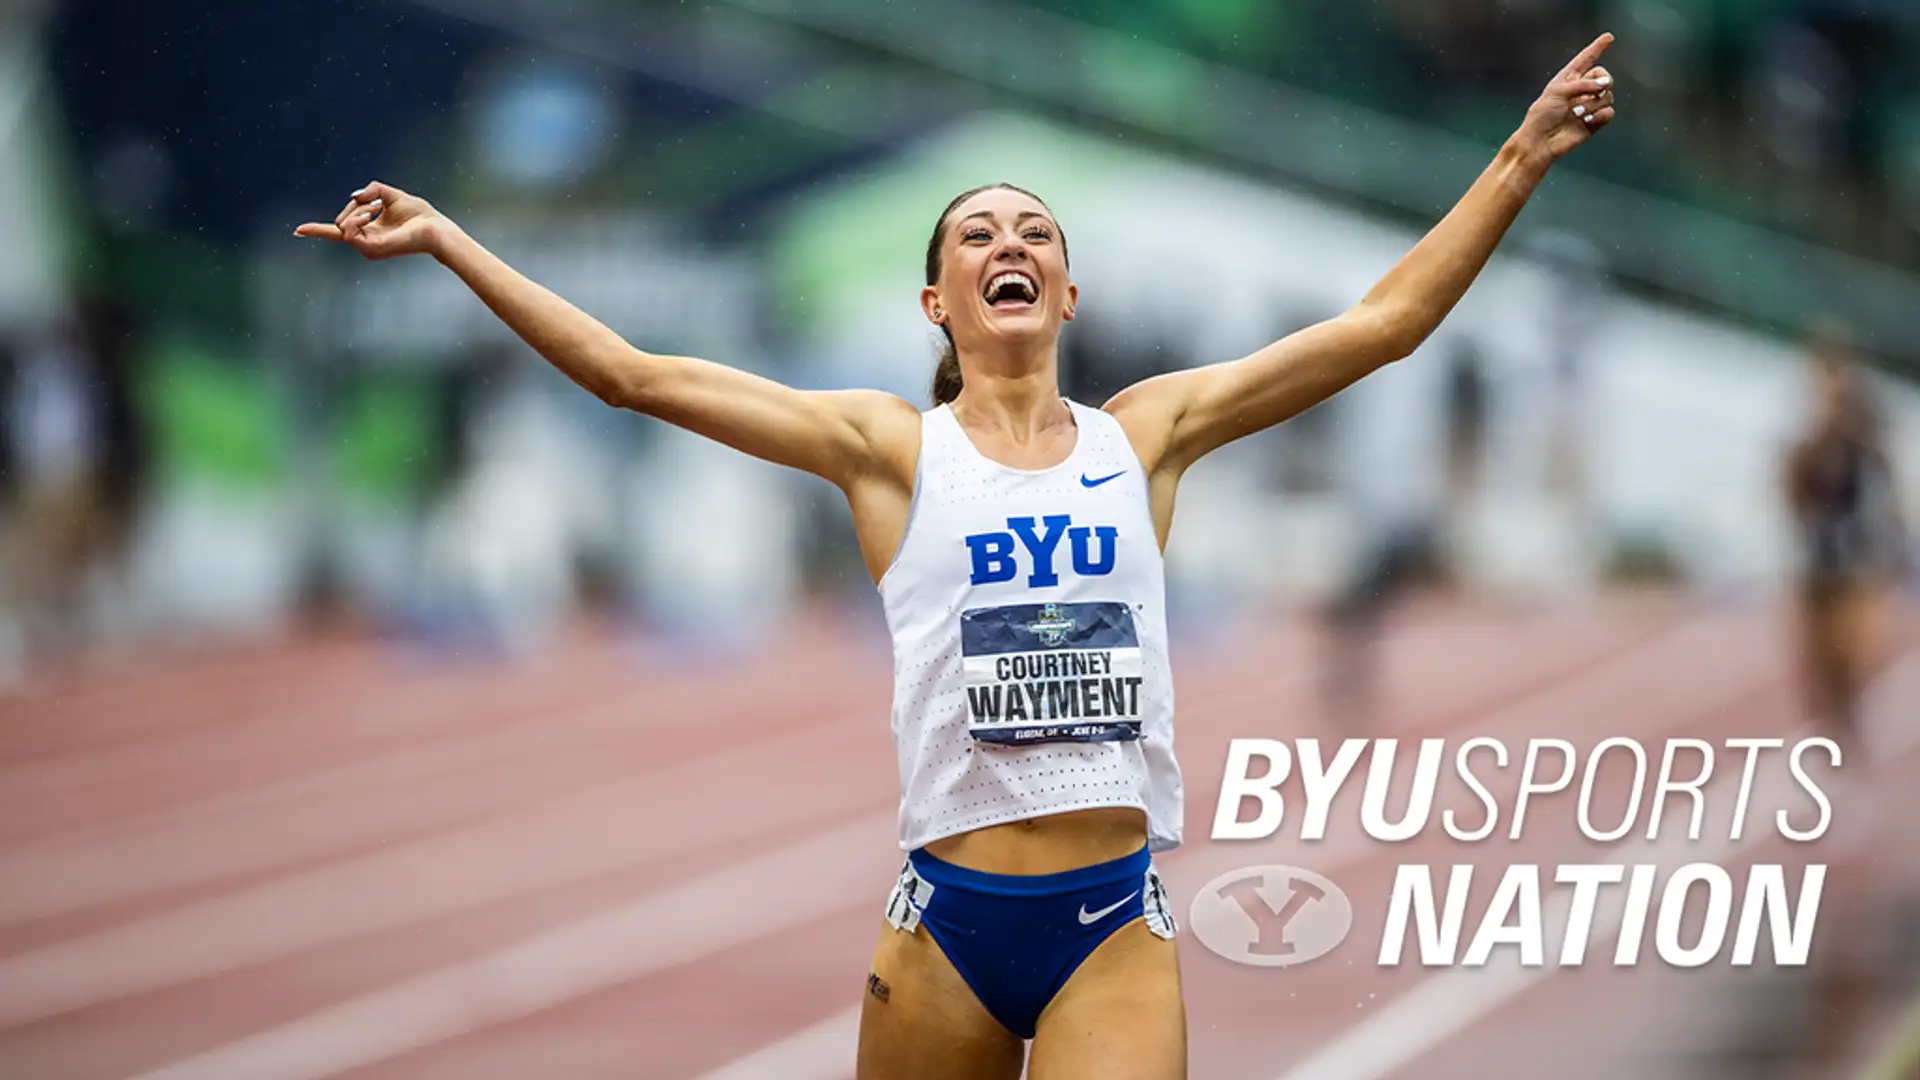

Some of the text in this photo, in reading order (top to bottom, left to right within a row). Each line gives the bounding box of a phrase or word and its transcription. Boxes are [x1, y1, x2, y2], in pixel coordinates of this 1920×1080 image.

[965, 514, 1119, 588] BYU
[996, 651, 1111, 681] COURTNEY
[967, 677, 1142, 723] WAYMENT
